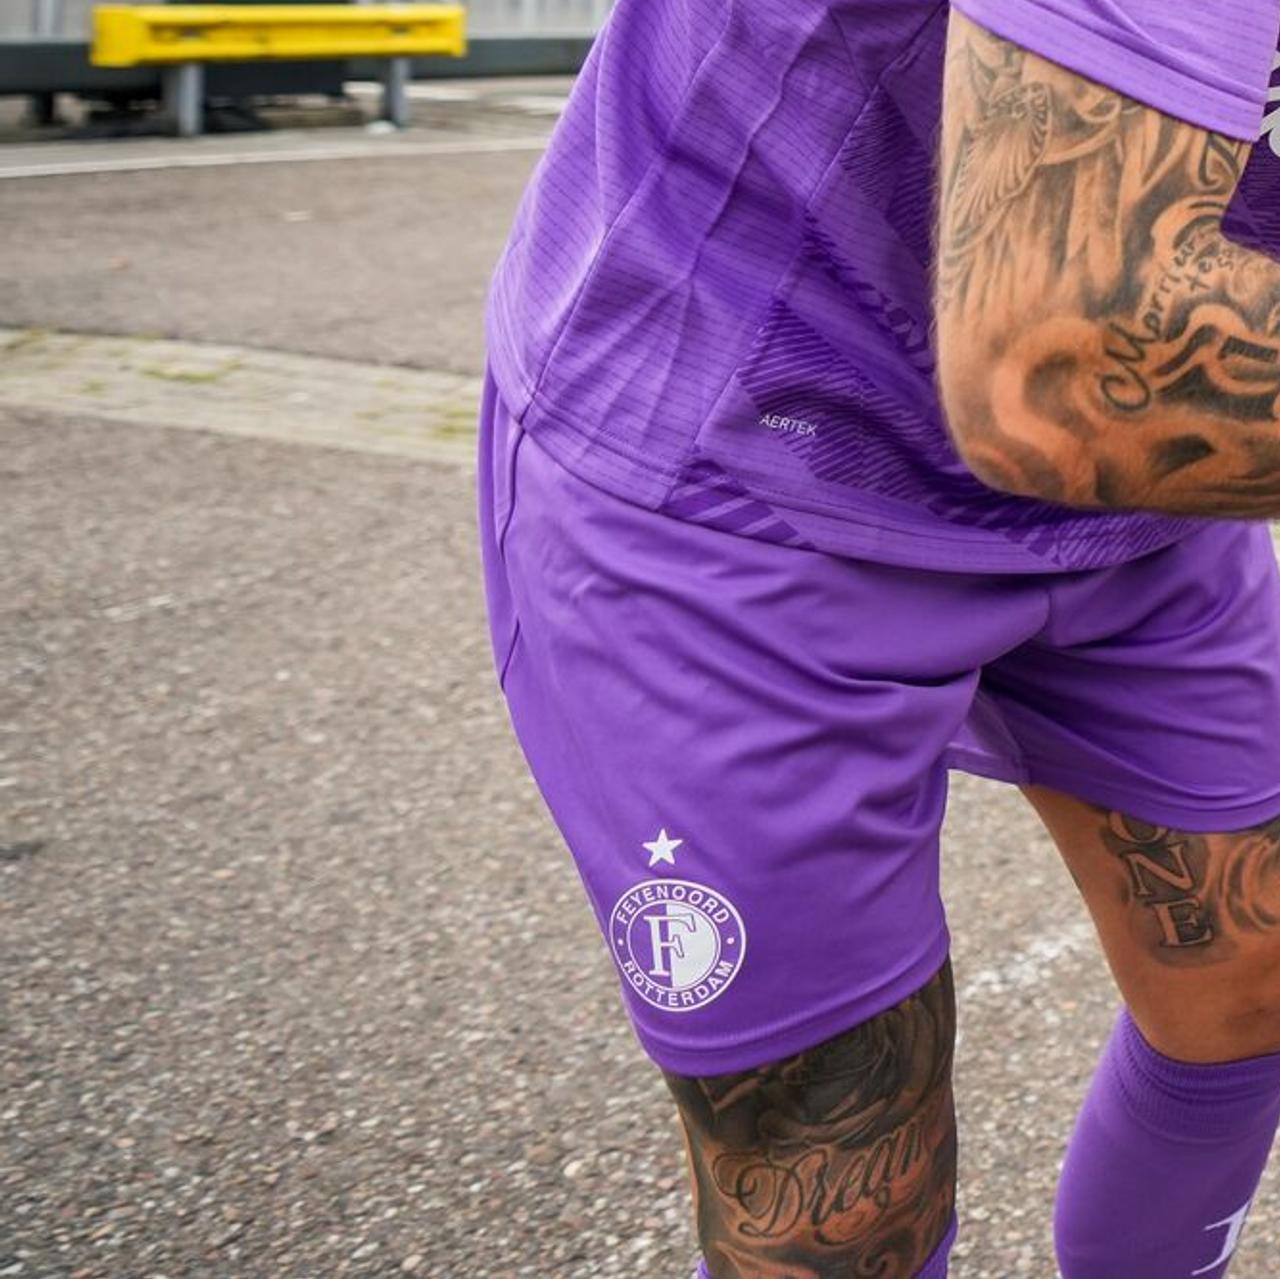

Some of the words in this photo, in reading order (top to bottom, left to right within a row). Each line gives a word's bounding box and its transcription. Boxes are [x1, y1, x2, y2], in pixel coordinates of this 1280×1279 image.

[759, 413, 818, 437] AERTEK
[615, 885, 731, 925] FEYENOORD
[623, 960, 735, 1007] ROTTERDAM
